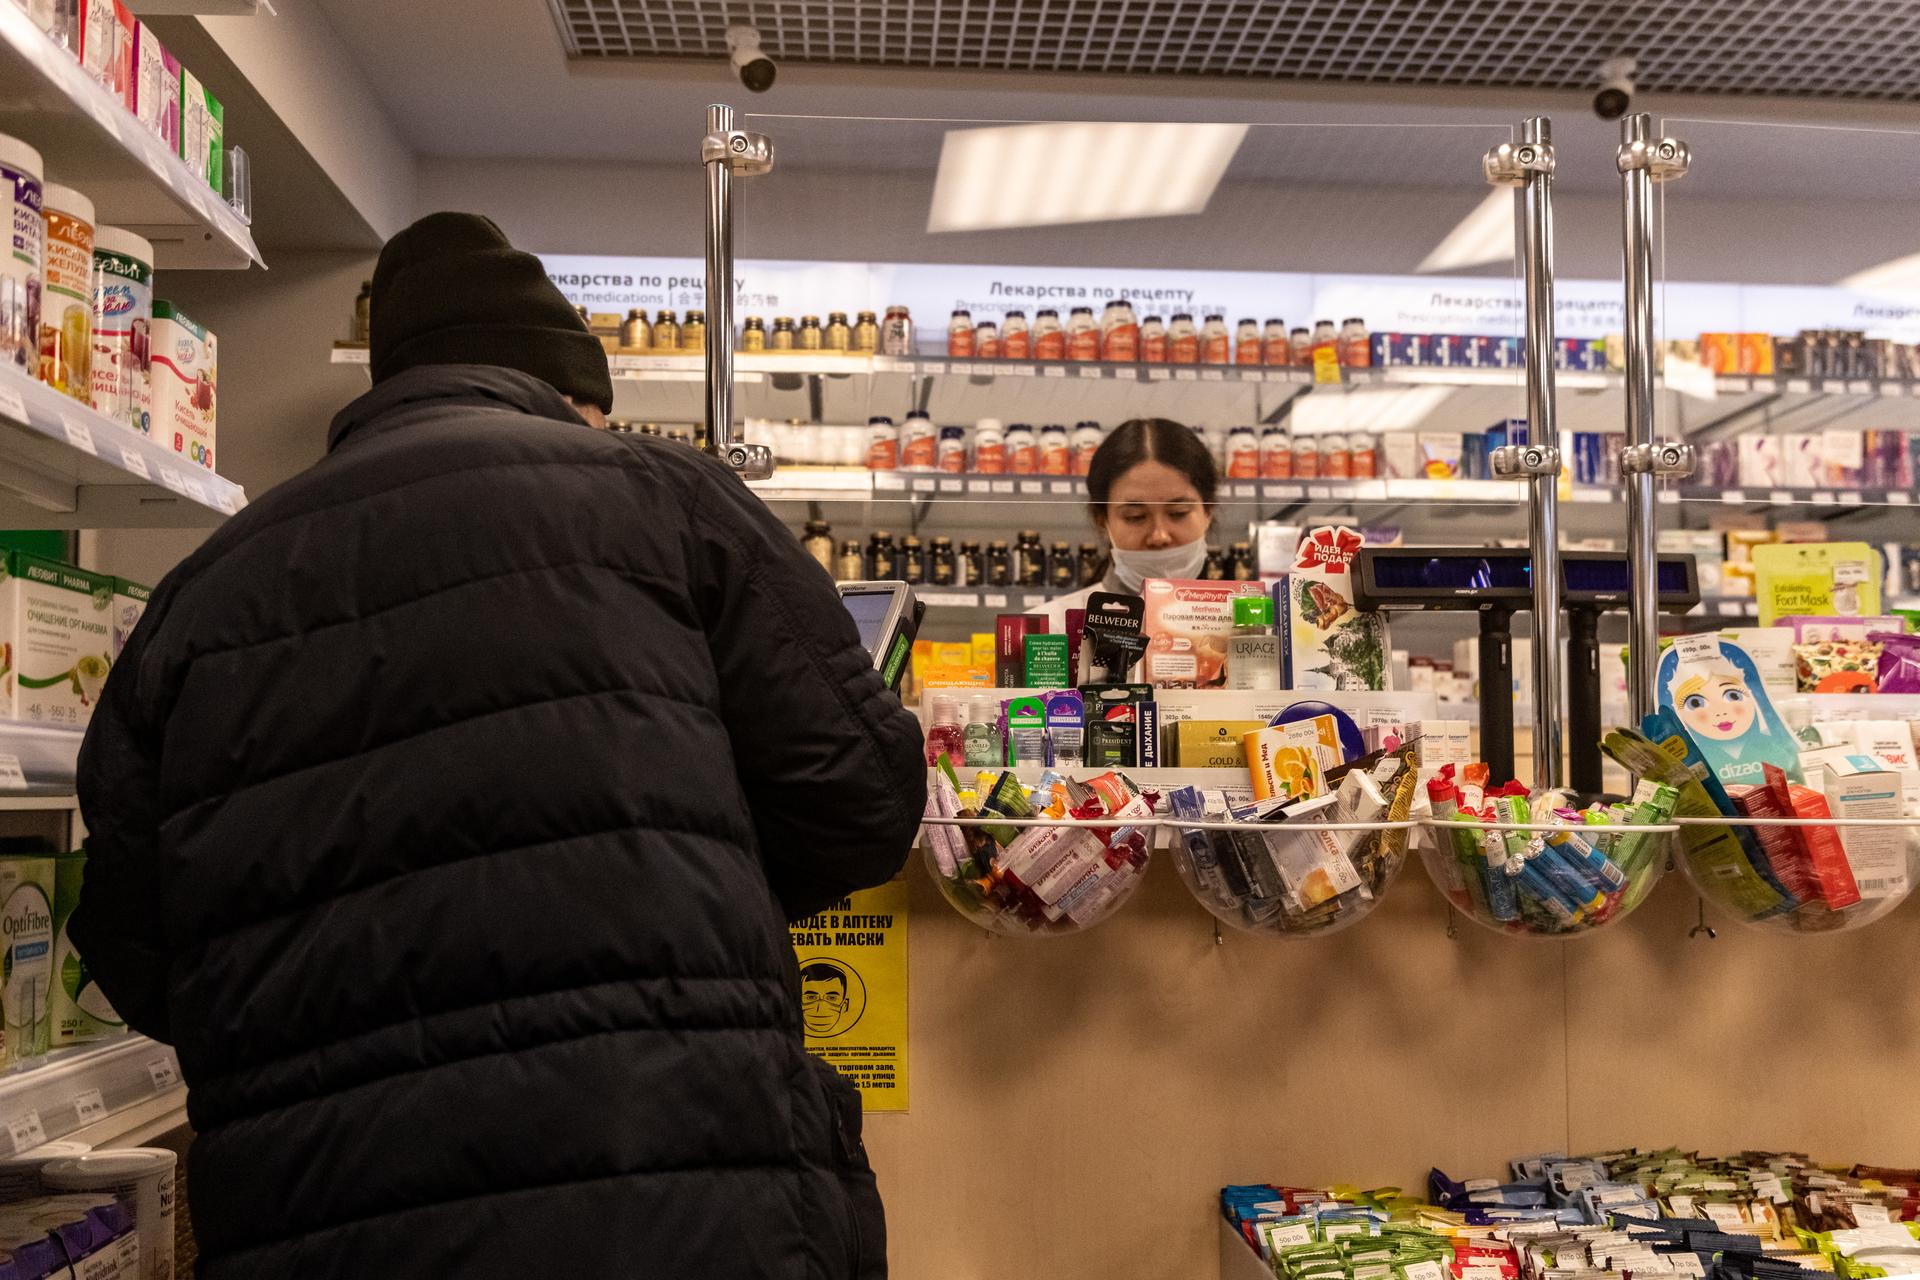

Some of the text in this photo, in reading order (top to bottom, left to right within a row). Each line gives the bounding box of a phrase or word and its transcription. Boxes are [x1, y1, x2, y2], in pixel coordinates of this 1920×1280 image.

[548, 273, 633, 289] екарства
[640, 276, 662, 287] по
[582, 292, 664, 304] medications
[990, 281, 1195, 302] Лекарства по рецепту
[1314, 544, 1341, 555] ИДЕЯ
[1775, 594, 1829, 606] Foot Mask
[1088, 614, 1139, 629] BELWEDER
[1235, 641, 1275, 655] URIAGE
[1144, 710, 1154, 758] ДЫХАНИЕ
[1261, 742, 1270, 761] Мед
[1209, 756, 1242, 765] GOLD &
[1718, 762, 1763, 779] dizao
[1266, 769, 1277, 798] ельсин
[3, 906, 50, 939] OptiFibre
[831, 915, 839, 928] В
[843, 915, 893, 928] АПТЕКУ
[792, 933, 884, 945] ЕВАТЬ МАСКИ
[61, 1019, 78, 1029] 250
[1279, 1234, 1292, 1244] 50р
